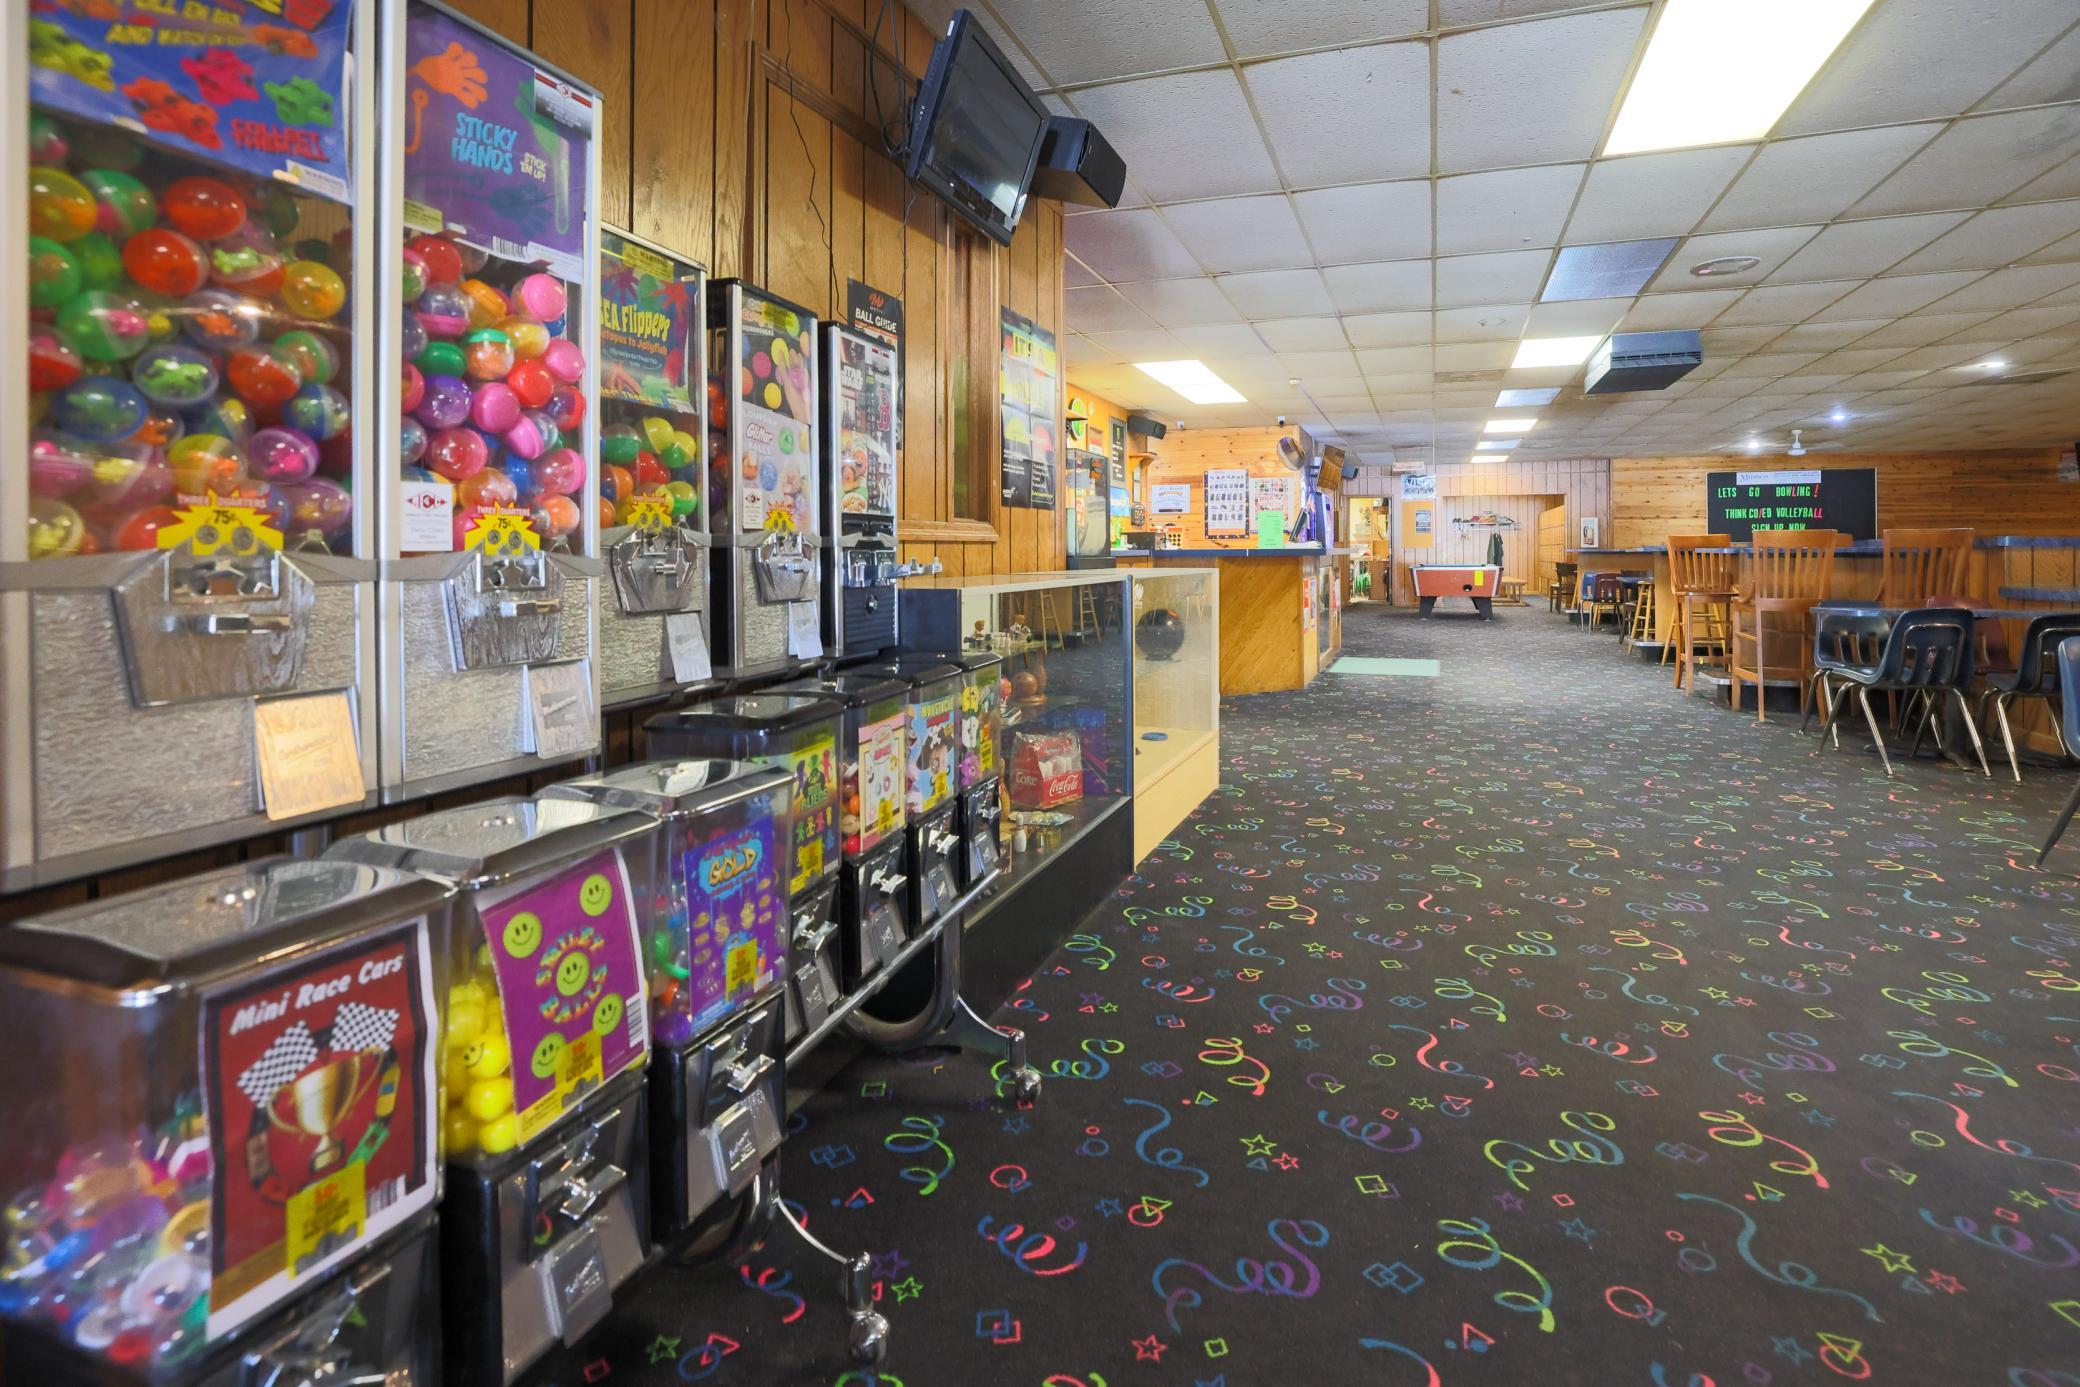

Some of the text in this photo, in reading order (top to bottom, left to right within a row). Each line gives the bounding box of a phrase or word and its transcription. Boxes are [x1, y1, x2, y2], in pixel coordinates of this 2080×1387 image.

[455, 112, 518, 151] STICKY
[450, 138, 513, 175] HANDS
[622, 303, 671, 342] Flippers
[855, 307, 897, 333] BALL GUIDE
[177, 493, 268, 509] THREE QUARTERS
[1718, 487, 1737, 498] LETS
[1748, 486, 1760, 498] GO
[477, 505, 498, 515] THREE
[1725, 508, 1747, 519] THINK
[1776, 507, 1823, 519] VOLLEYBALL
[708, 847, 758, 886] GOLD
[229, 953, 404, 1036] Mini Race Cars
